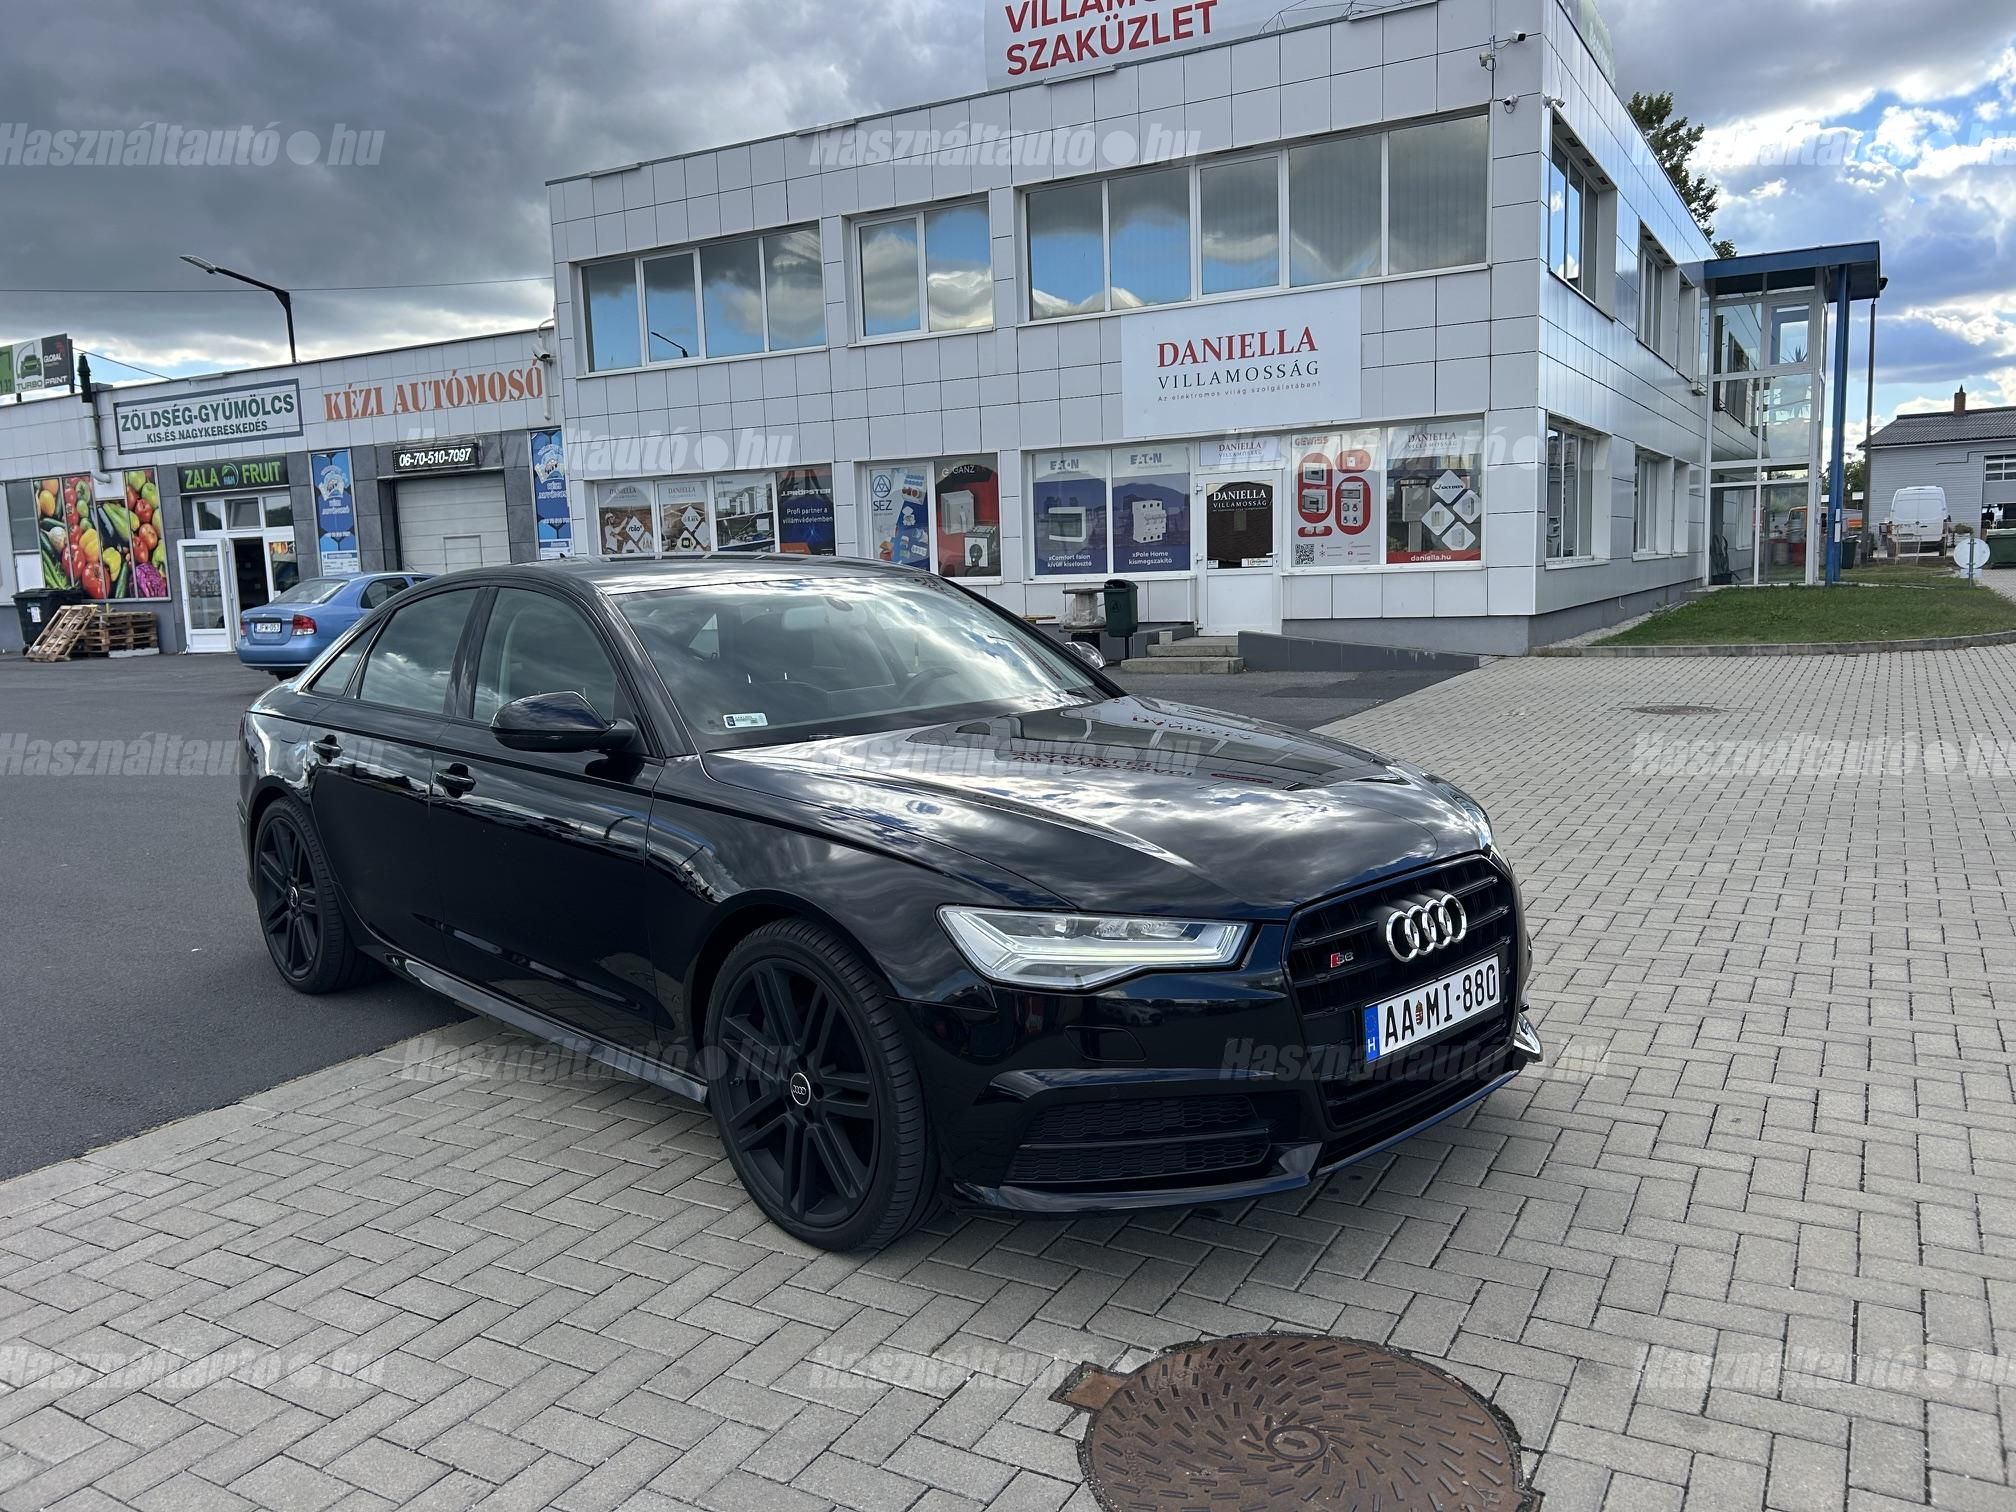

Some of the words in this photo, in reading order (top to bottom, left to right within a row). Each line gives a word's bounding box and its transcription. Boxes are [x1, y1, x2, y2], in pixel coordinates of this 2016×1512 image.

[1007, 1, 1217, 75] SZAKÜZLET
[1157, 326, 1318, 368] DANIELLA
[1158, 359, 1319, 389] VILLAMOSSÁG
[16, 380, 43, 391] TURBO
[44, 375, 68, 386] PRINT
[323, 383, 384, 422] KÉZI
[393, 360, 543, 414] AUTÓMOSÓ
[120, 393, 295, 432] ZÖLDSÉG-GYÜMÖLCS
[178, 420, 268, 441] NAGYKERESKEDÉS
[1407, 431, 1457, 443] DANIELLA
[1218, 441, 1263, 452] DANIELLA
[399, 448, 472, 467] 06-70-510-7097
[184, 467, 220, 490] ZALA
[241, 461, 281, 484] FRUIT
[952, 465, 975, 475] GANZ
[1213, 489, 1267, 501] DANIELLA
[802, 507, 823, 516] partner
[873, 499, 893, 512] SEZ
[1410, 553, 1452, 562] daniella.hu
[1367, 1036, 1377, 1053] H
